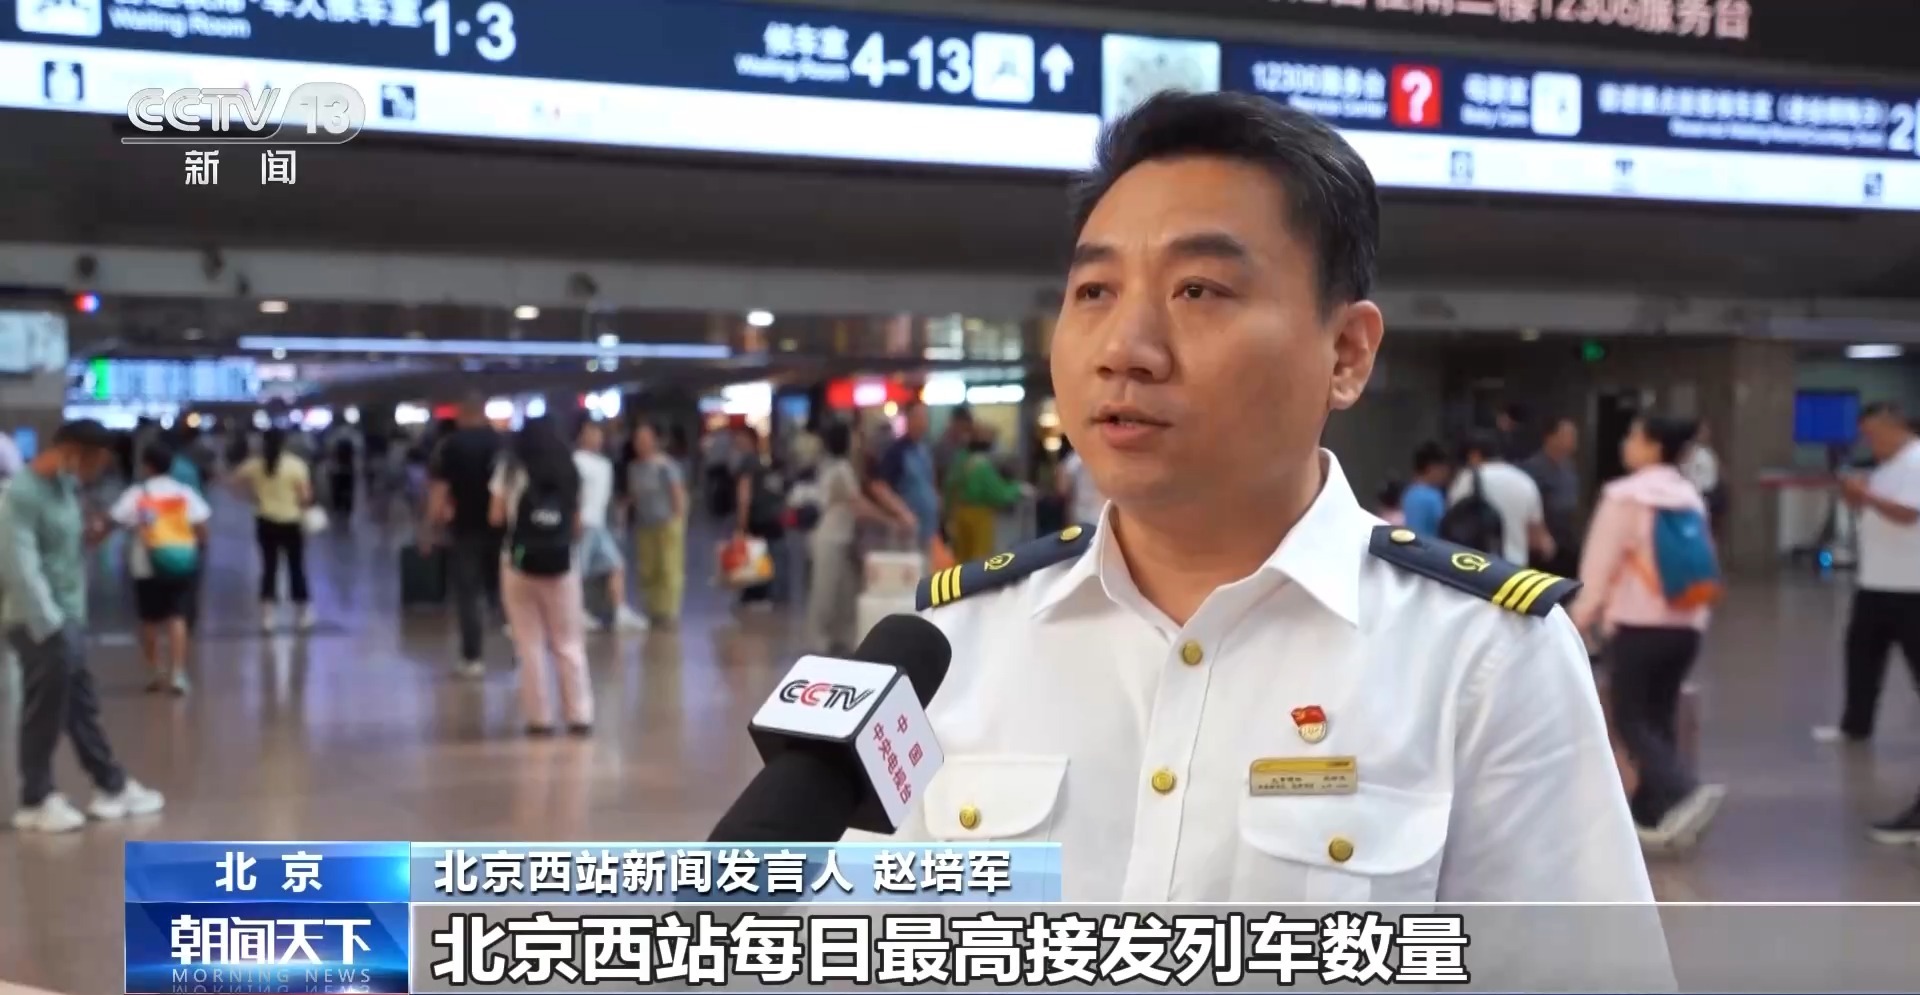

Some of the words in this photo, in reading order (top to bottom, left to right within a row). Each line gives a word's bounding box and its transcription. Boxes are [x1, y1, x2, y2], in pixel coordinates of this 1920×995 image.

[779, 679, 876, 711] CCTV
[872, 722, 913, 804] 中央电视台
